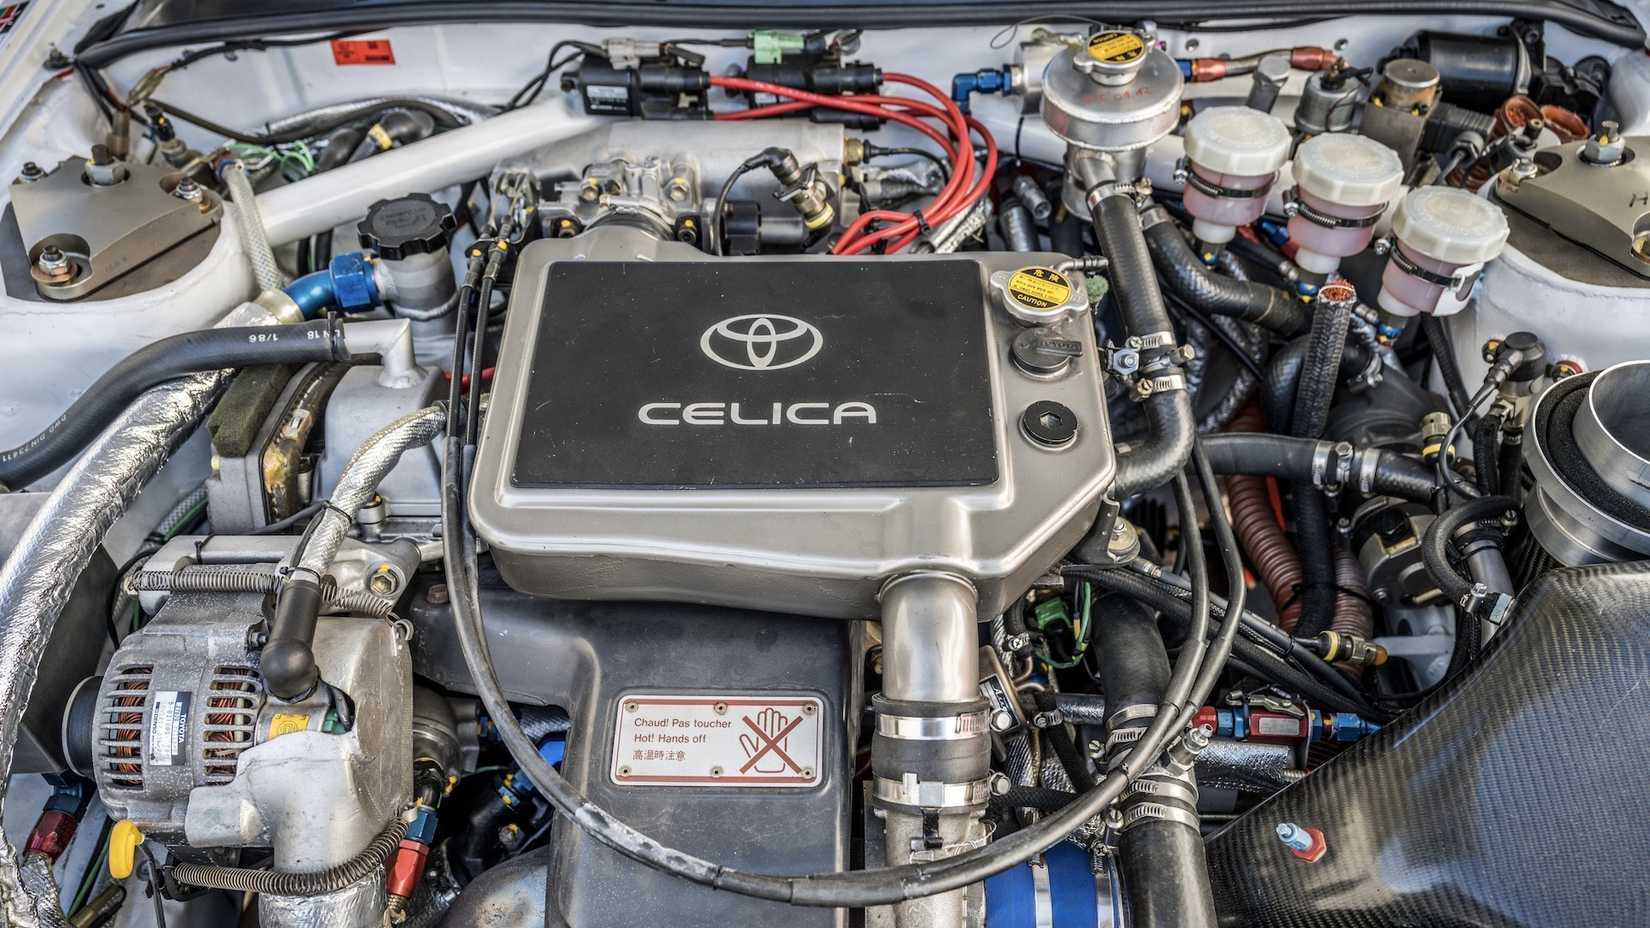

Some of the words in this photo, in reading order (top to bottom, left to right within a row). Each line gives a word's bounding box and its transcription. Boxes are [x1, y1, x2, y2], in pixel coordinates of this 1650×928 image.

[1017, 294, 1048, 307] CAUTION
[248, 333, 278, 343] 1/86
[638, 401, 877, 425] CELICA
[179, 713, 187, 744] TOYOTA
[634, 718, 669, 727] Chaud!
[672, 718, 690, 728] Pas
[694, 719, 732, 728] toucher
[634, 734, 655, 743] Hot!
[658, 734, 690, 744] Hands
[692, 734, 707, 744] off
